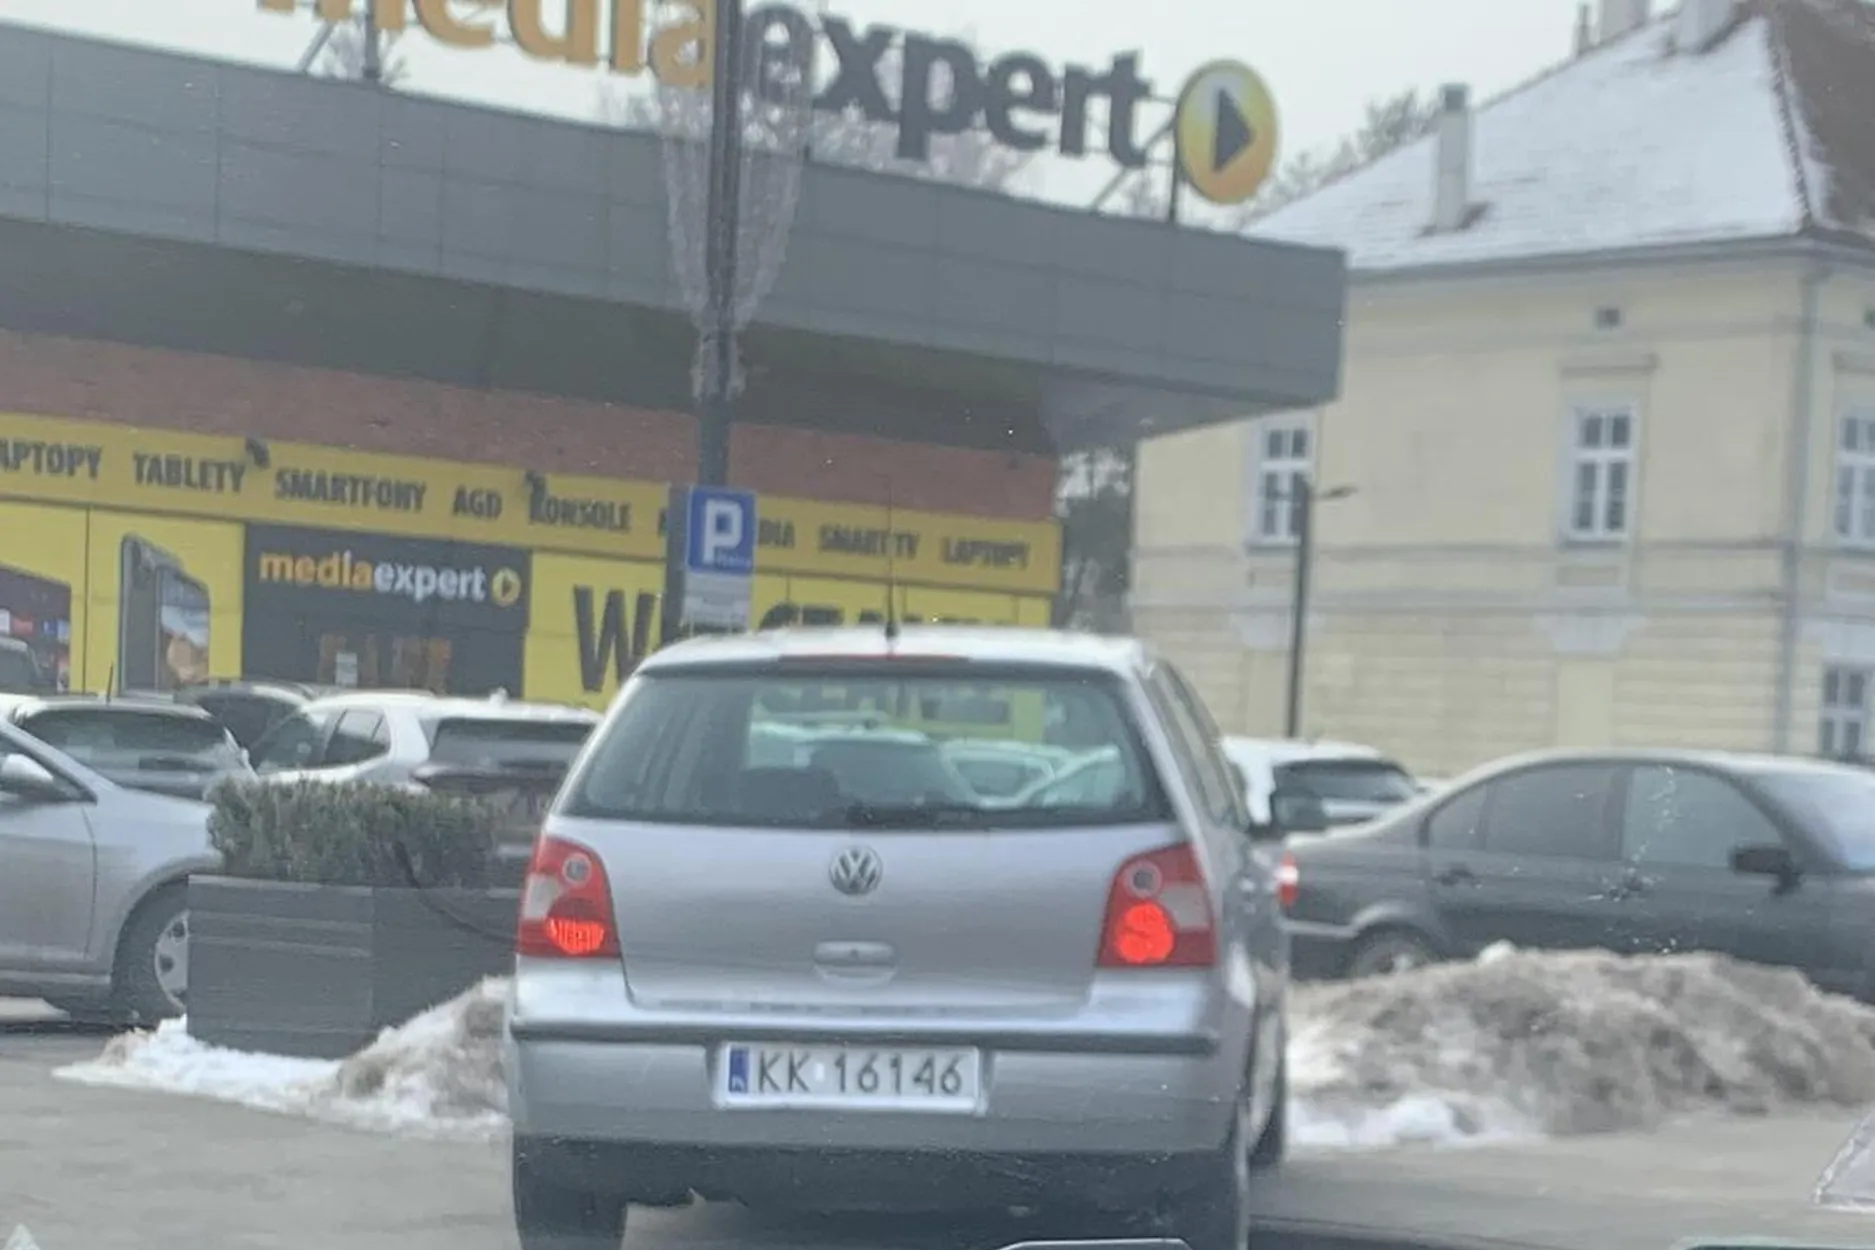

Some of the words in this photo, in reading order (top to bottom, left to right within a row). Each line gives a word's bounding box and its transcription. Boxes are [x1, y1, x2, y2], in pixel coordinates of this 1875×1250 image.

[132, 452, 246, 493] TABLETY
[275, 466, 427, 514] SMARTFONY
[452, 483, 503, 520] AGD
[702, 499, 744, 565] P
[259, 550, 487, 603] mediaexpert
[758, 1049, 811, 1094] KK
[834, 1051, 964, 1097] 16146
